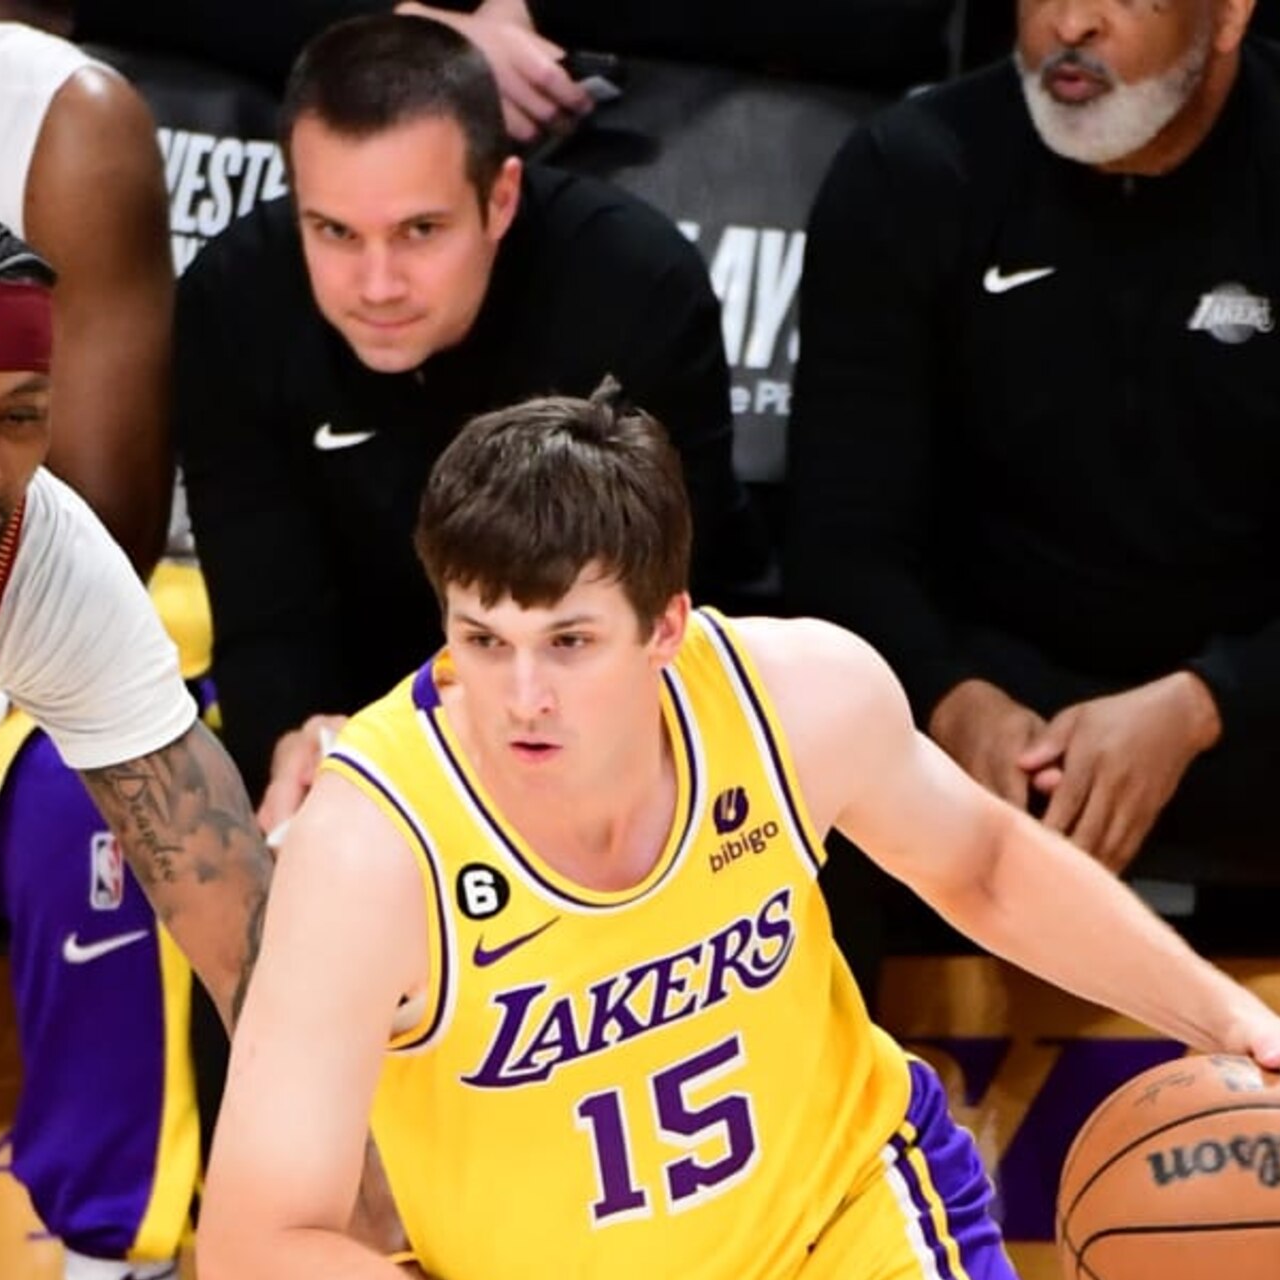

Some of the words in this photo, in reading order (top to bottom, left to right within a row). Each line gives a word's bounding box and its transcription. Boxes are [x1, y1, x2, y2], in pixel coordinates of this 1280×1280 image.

[462, 869, 500, 916] 6
[710, 819, 780, 874] bibigo
[458, 886, 797, 1090] LAKERS
[576, 1032, 760, 1229] 15
